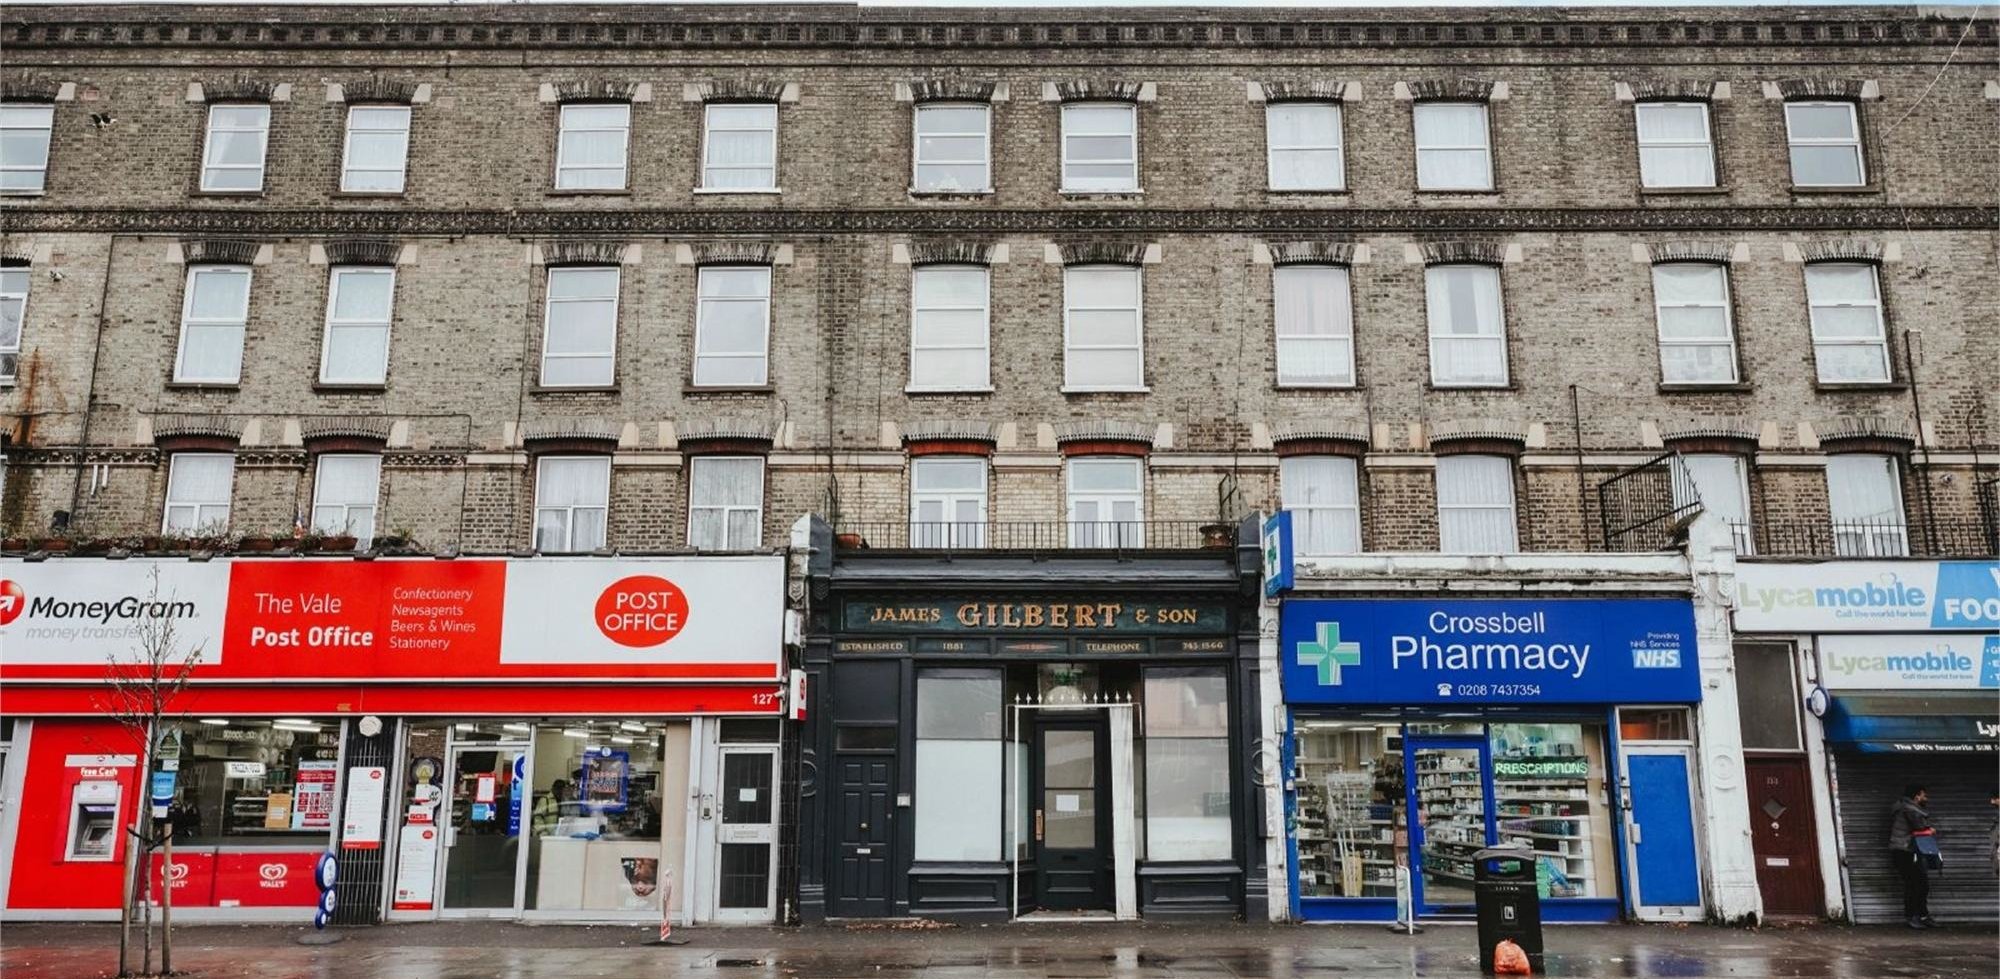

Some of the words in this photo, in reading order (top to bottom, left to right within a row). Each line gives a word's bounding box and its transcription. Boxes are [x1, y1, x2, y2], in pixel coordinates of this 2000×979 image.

[392, 586, 474, 602] Confectionery
[616, 591, 673, 609] POST
[1739, 581, 1926, 613] Lycamobile
[29, 596, 195, 625] MoneyGram
[254, 592, 293, 614] The
[299, 592, 342, 614] Vale
[391, 603, 464, 619] Newsagents
[604, 613, 678, 632] OFFICE
[870, 607, 941, 623] JAMES
[957, 603, 1121, 628] GILBERT
[1135, 608, 1150, 623] &
[1158, 608, 1198, 624] SON
[1429, 611, 1545, 634] Crossbell
[390, 619, 424, 633] Beers
[428, 619, 437, 633] &
[441, 619, 476, 633] Wines
[26, 627, 81, 643] money
[251, 627, 300, 647] Post
[307, 626, 374, 647] Office
[389, 635, 451, 651] Stationery
[1647, 632, 1680, 641] Providing
[840, 641, 904, 651] ESTABLISHED
[1085, 641, 1140, 652] TELEPHONE
[1649, 640, 1681, 648] Services
[1392, 636, 1591, 678] Pharmacy
[1635, 649, 1680, 668] NHS
[1827, 651, 1972, 675] Lycamobile
[1458, 684, 1487, 697] 0208
[1490, 684, 1541, 697] 7437354
[752, 694, 773, 705] 127
[80, 767, 97, 777] Free
[99, 767, 118, 777] Cash
